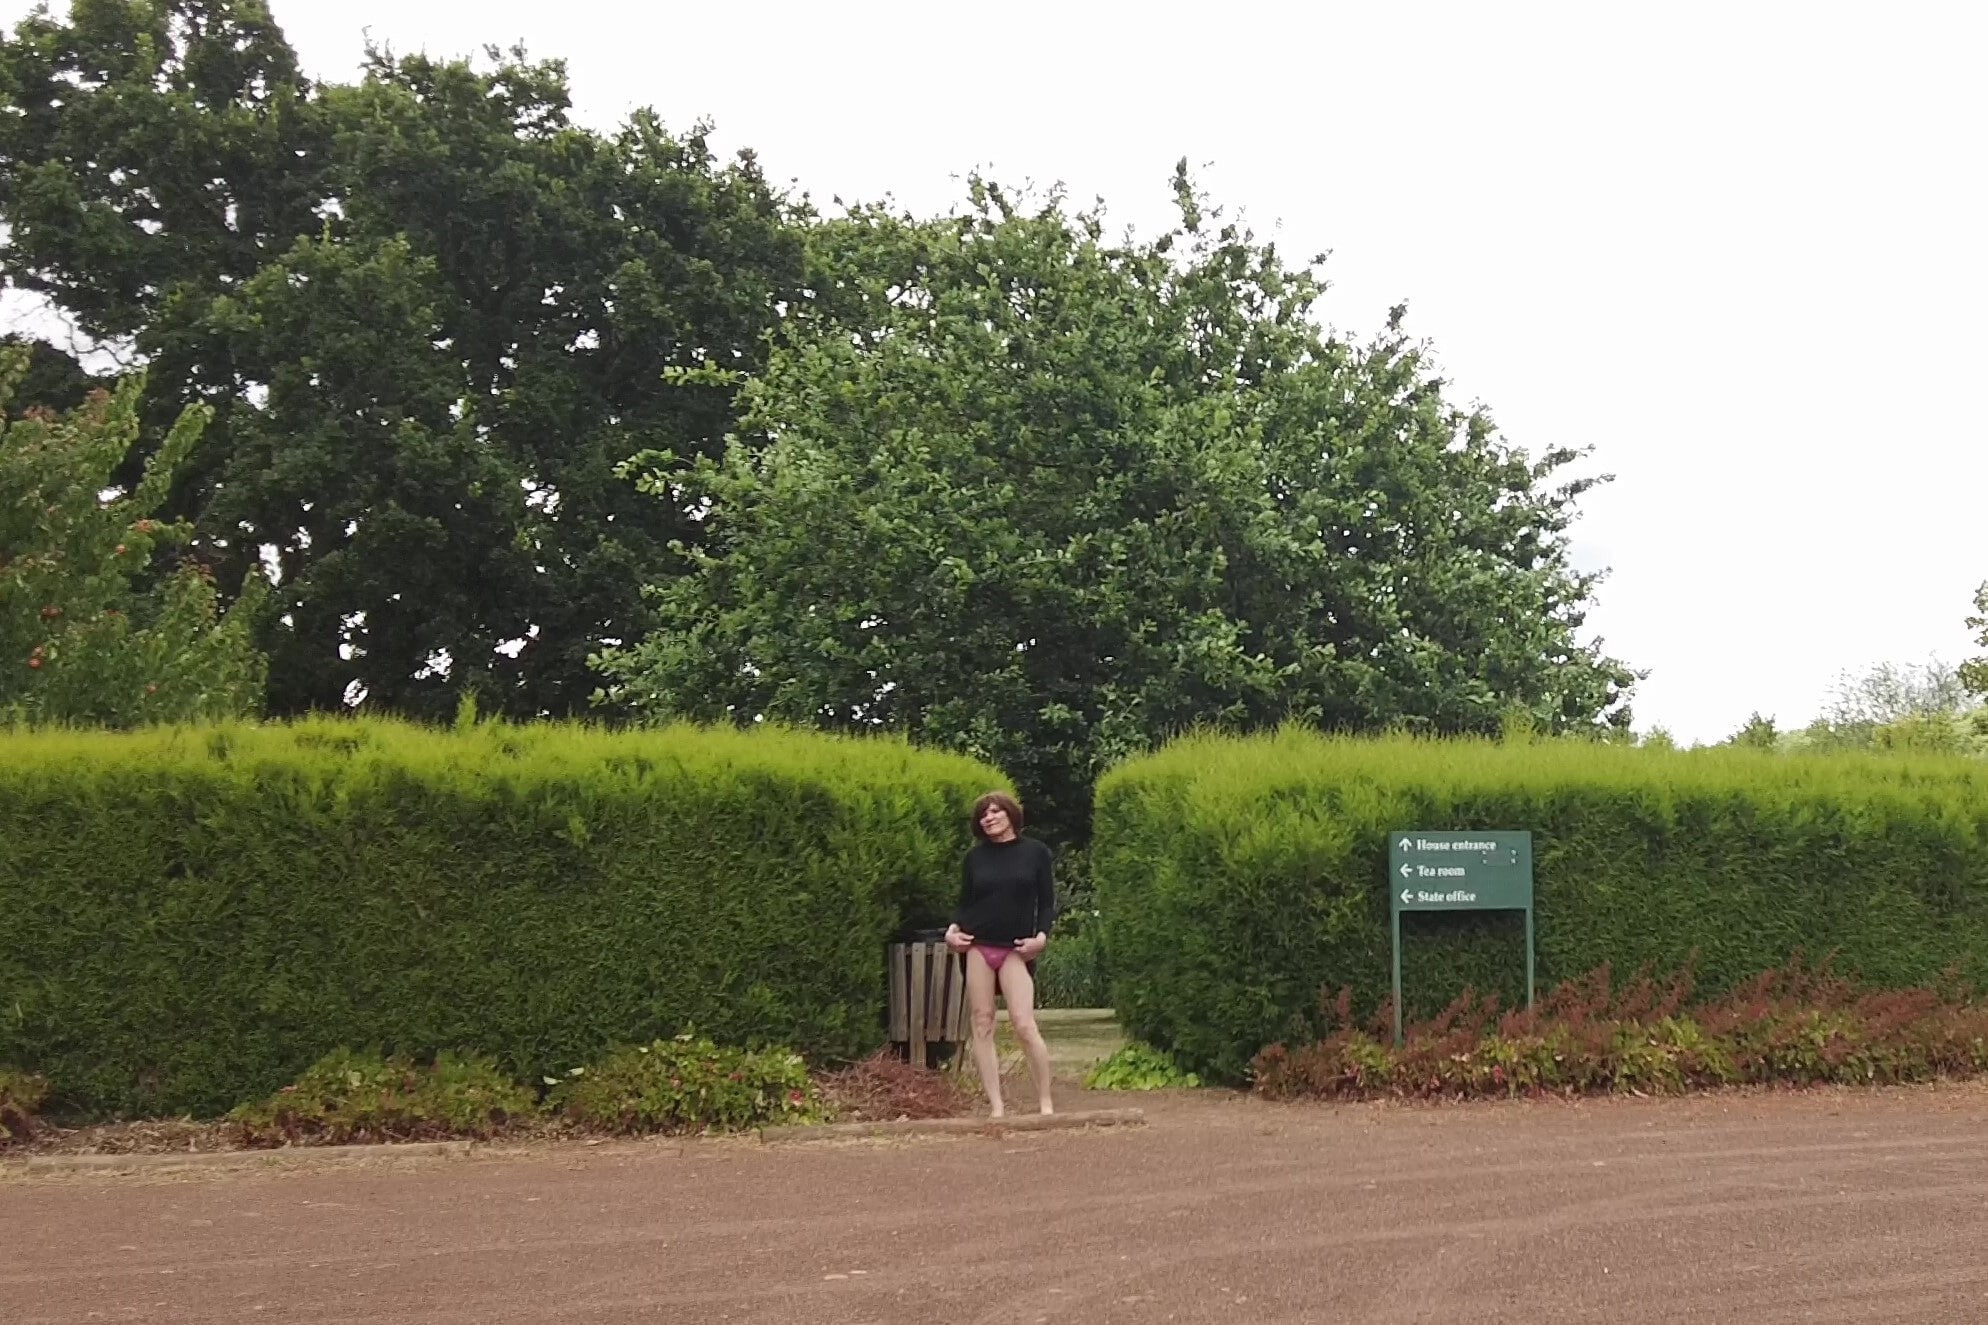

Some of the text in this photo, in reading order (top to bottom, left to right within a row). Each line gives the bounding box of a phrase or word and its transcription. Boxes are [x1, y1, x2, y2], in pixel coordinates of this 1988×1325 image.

[1416, 839, 1497, 851] House entrance
[1416, 865, 1466, 877] Tea room
[1417, 890, 1477, 902] State office
